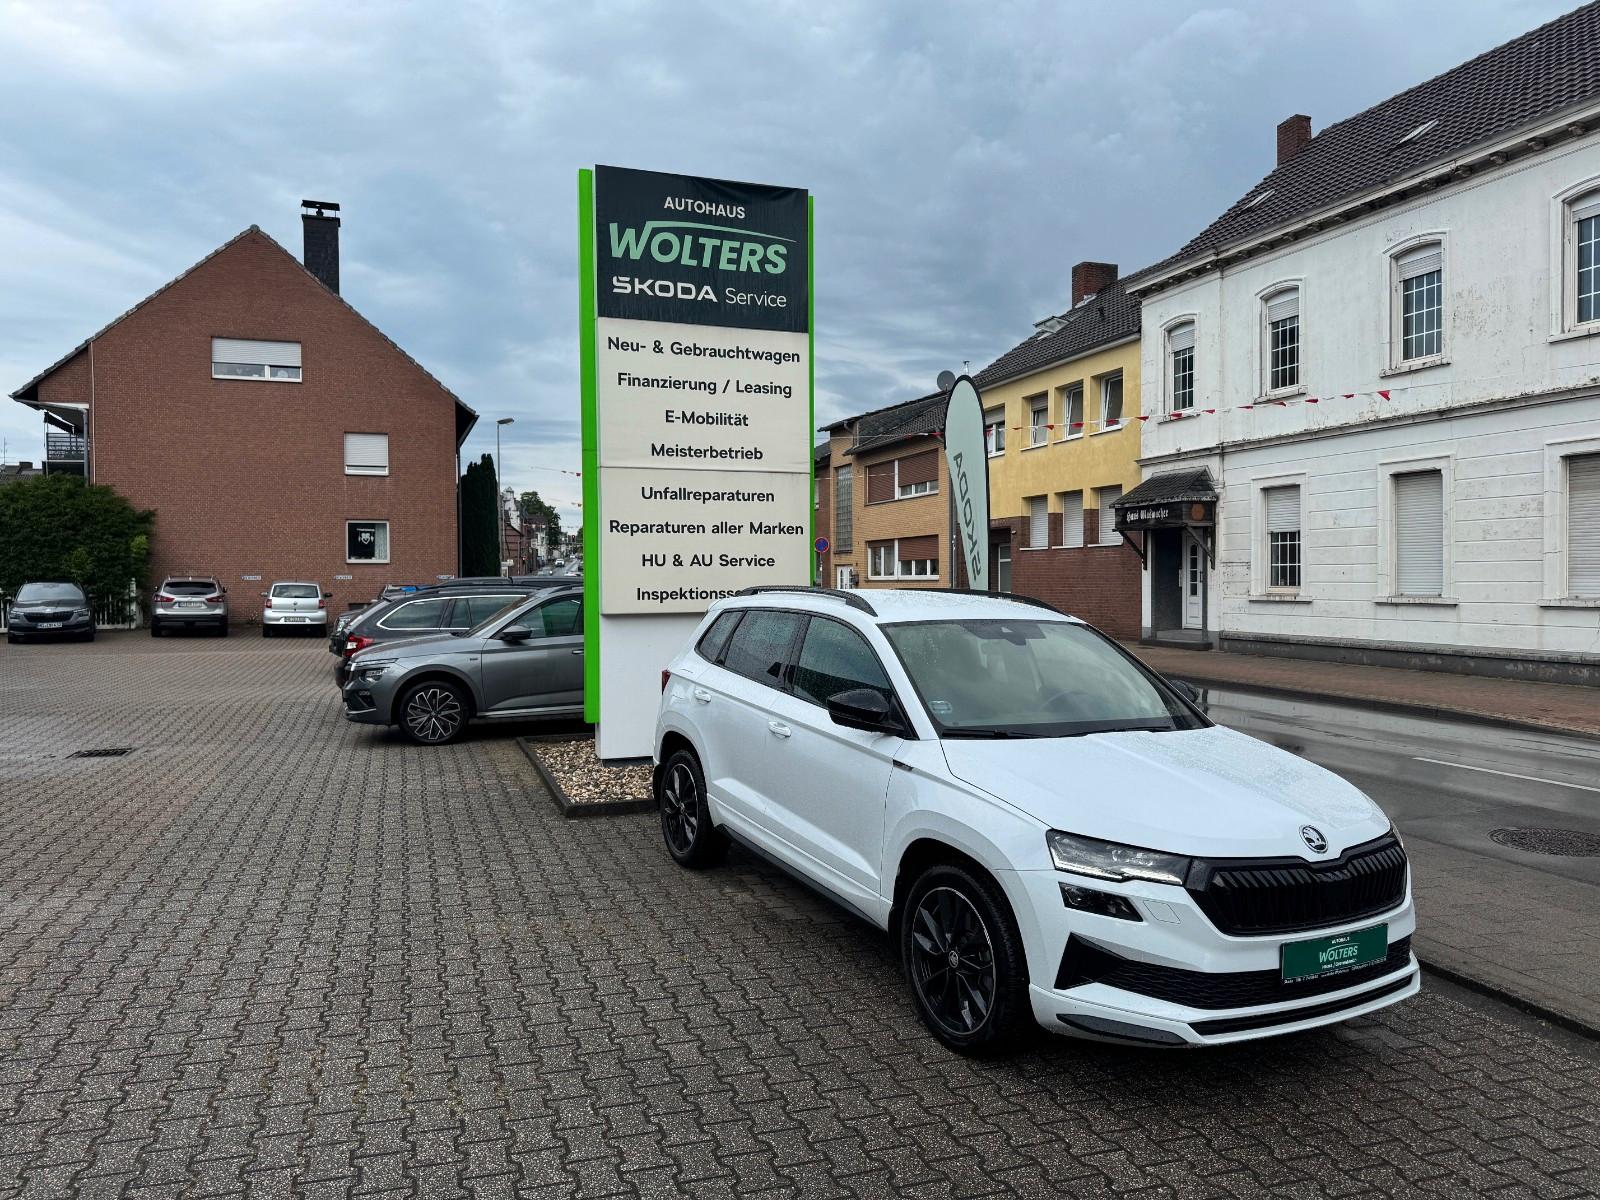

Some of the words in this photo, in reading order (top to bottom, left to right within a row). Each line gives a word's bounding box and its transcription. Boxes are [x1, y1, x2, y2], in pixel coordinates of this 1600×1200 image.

[663, 196, 746, 219] AUTOHAUS
[609, 220, 788, 275] WOLTERS
[725, 287, 787, 308] Service
[607, 336, 646, 352] Neu-
[652, 340, 664, 354] &
[670, 341, 801, 365] Gebrauchtwagen
[617, 372, 717, 395] Finanzierung
[722, 379, 731, 394] /
[736, 379, 792, 399] Leasing
[665, 409, 749, 427] E-Mobilität
[651, 443, 763, 460] Meisterbetrieb
[641, 486, 775, 504] Unfallreparaturen
[609, 519, 706, 536] Reparaturen
[711, 521, 744, 535] aller
[749, 521, 804, 536] Marken
[641, 554, 666, 567] HU
[672, 554, 684, 567] &
[689, 554, 713, 567] AU
[719, 553, 776, 567] Service
[1319, 944, 1358, 963] WOLTERS
